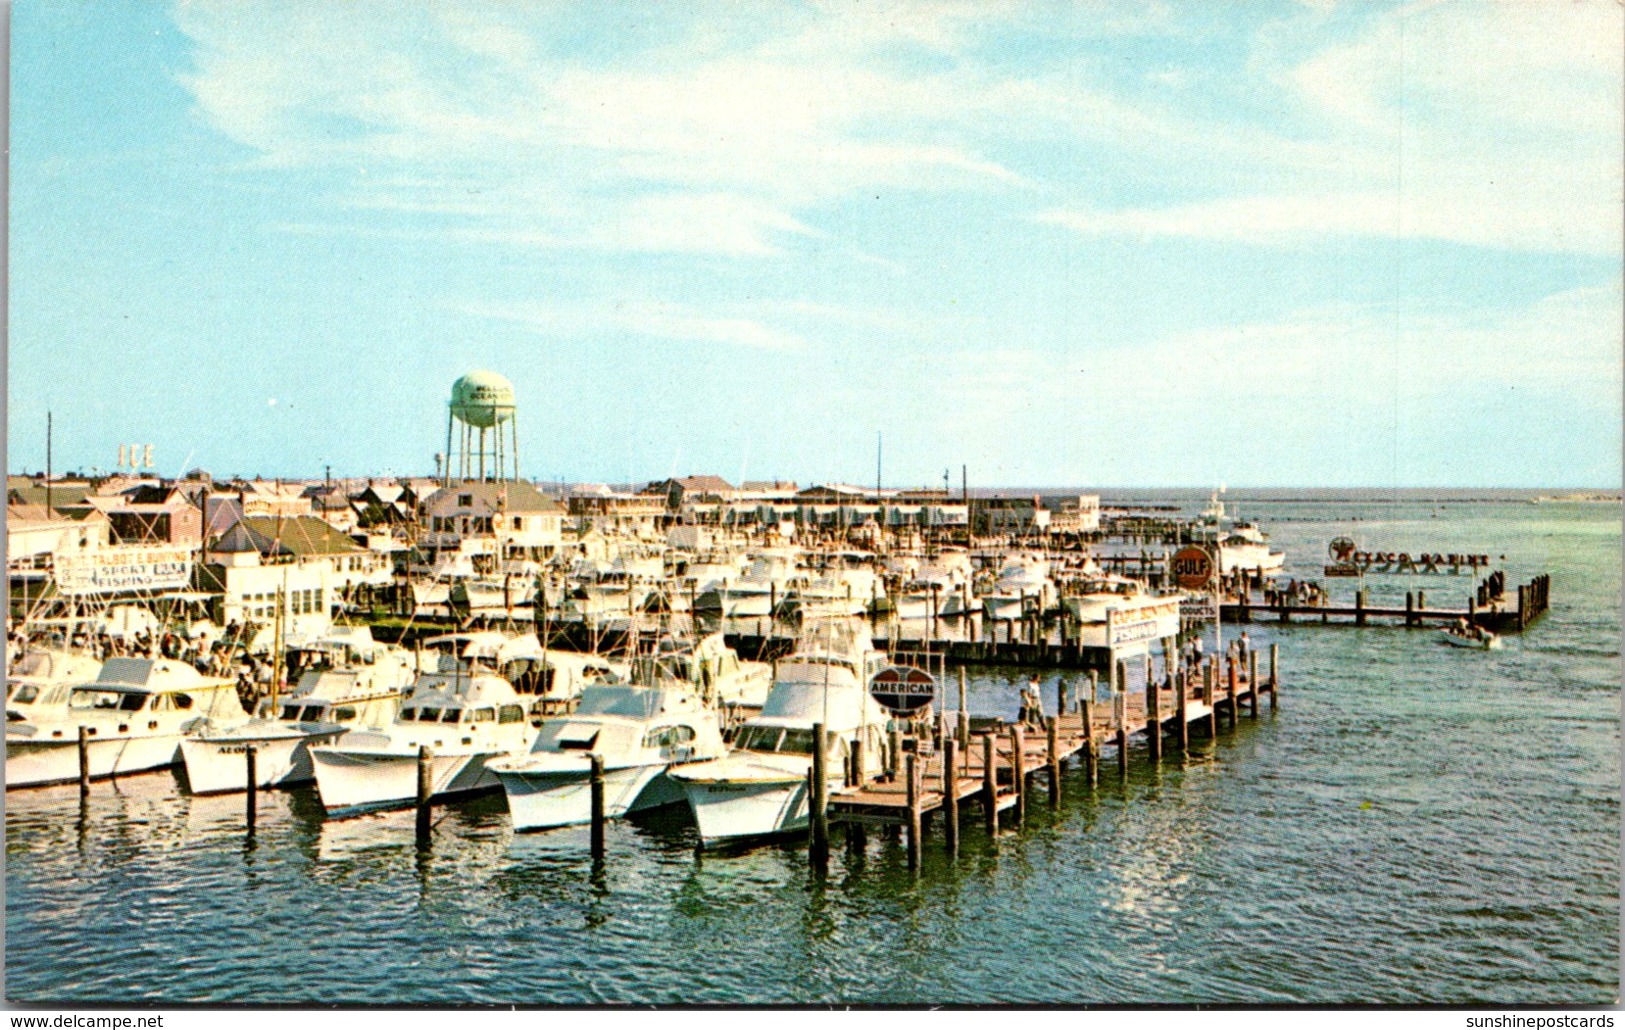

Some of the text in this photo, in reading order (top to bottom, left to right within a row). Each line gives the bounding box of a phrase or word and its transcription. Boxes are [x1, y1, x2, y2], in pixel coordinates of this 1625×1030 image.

[117, 443, 155, 468] ICE
[102, 564, 146, 576] SPORT
[1176, 558, 1207, 576] GULF
[871, 683, 934, 693] AMERICAN
